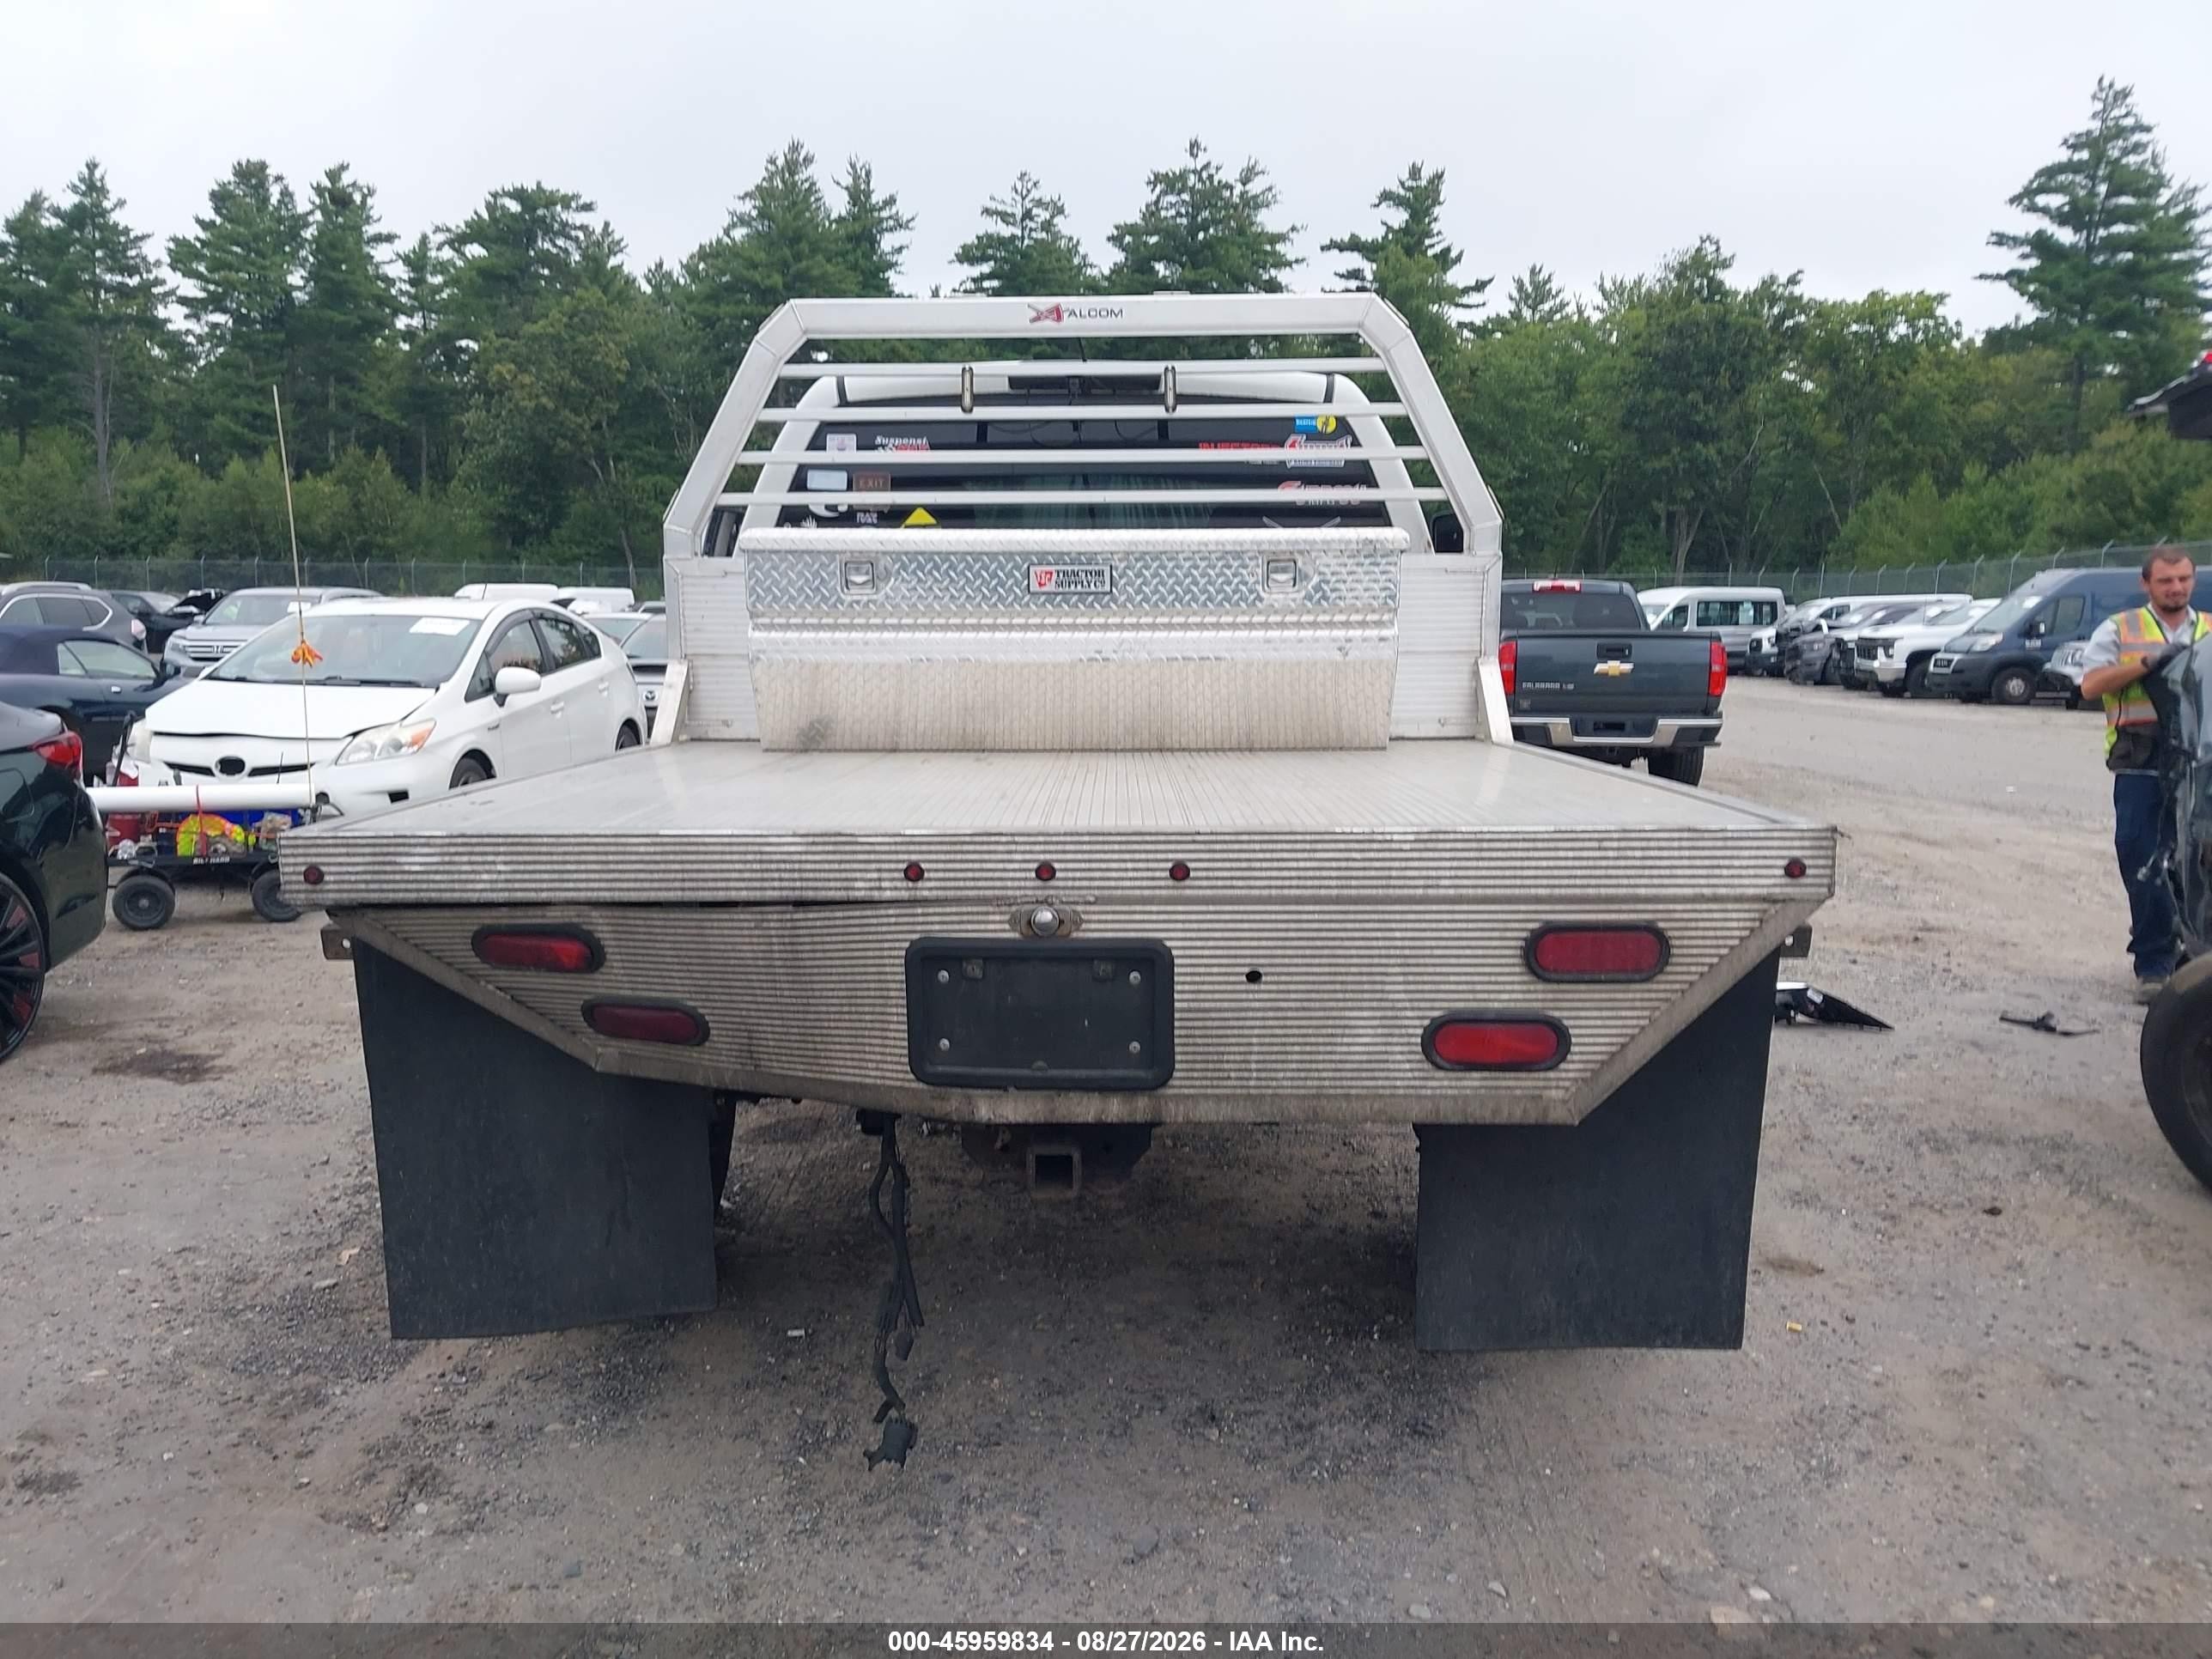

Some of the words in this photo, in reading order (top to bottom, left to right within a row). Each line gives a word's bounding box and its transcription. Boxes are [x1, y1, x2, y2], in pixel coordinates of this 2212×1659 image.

[859, 477, 884, 489] EXIT
[1054, 569, 1105, 578] TRACTOR
[1054, 580, 1092, 589] SUPPLY
